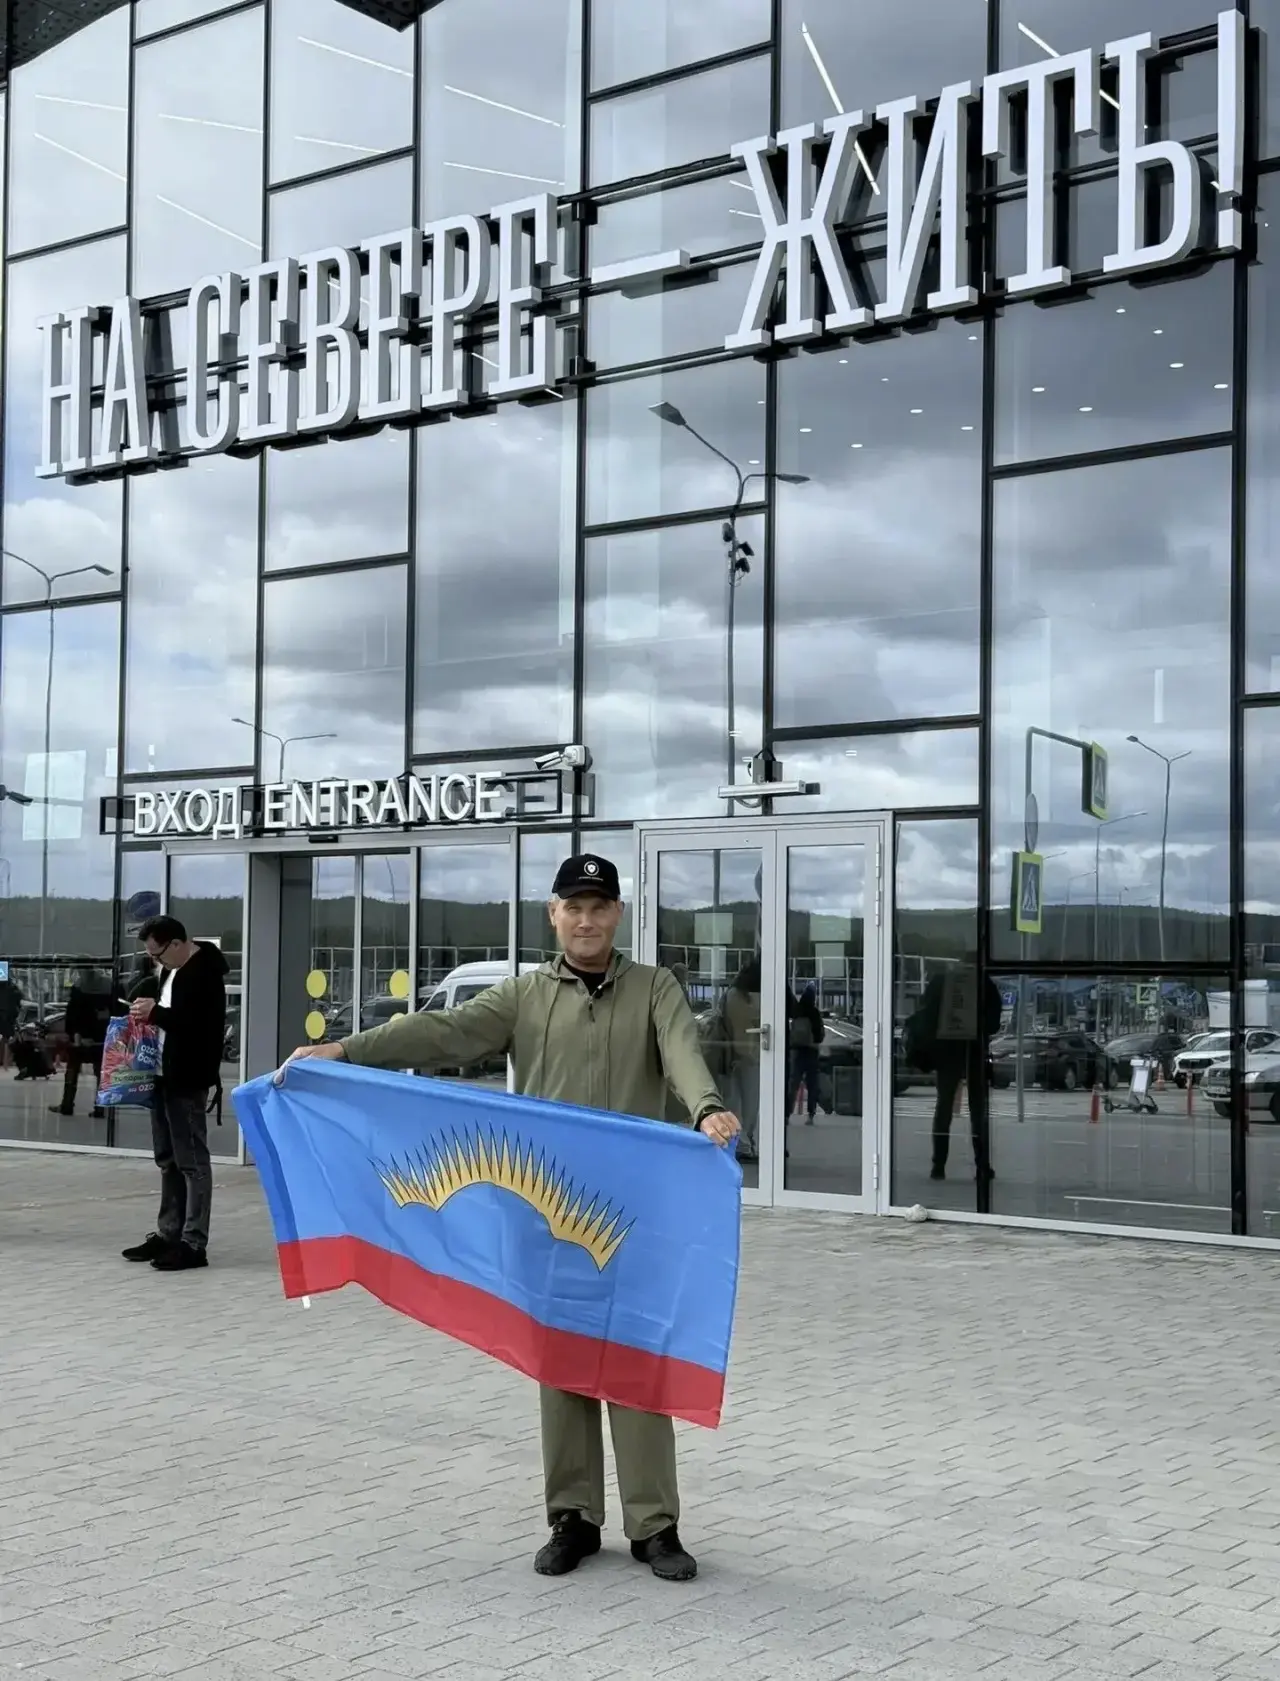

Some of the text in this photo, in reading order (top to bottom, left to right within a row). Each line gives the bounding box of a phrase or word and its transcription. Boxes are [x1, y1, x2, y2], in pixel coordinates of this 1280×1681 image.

[35, 296, 159, 479] НА
[187, 192, 558, 452] СЕВЕРЕ
[724, 8, 1246, 352] ЖИТЬ!
[134, 771, 506, 840] ВХОД ENTRANCE
